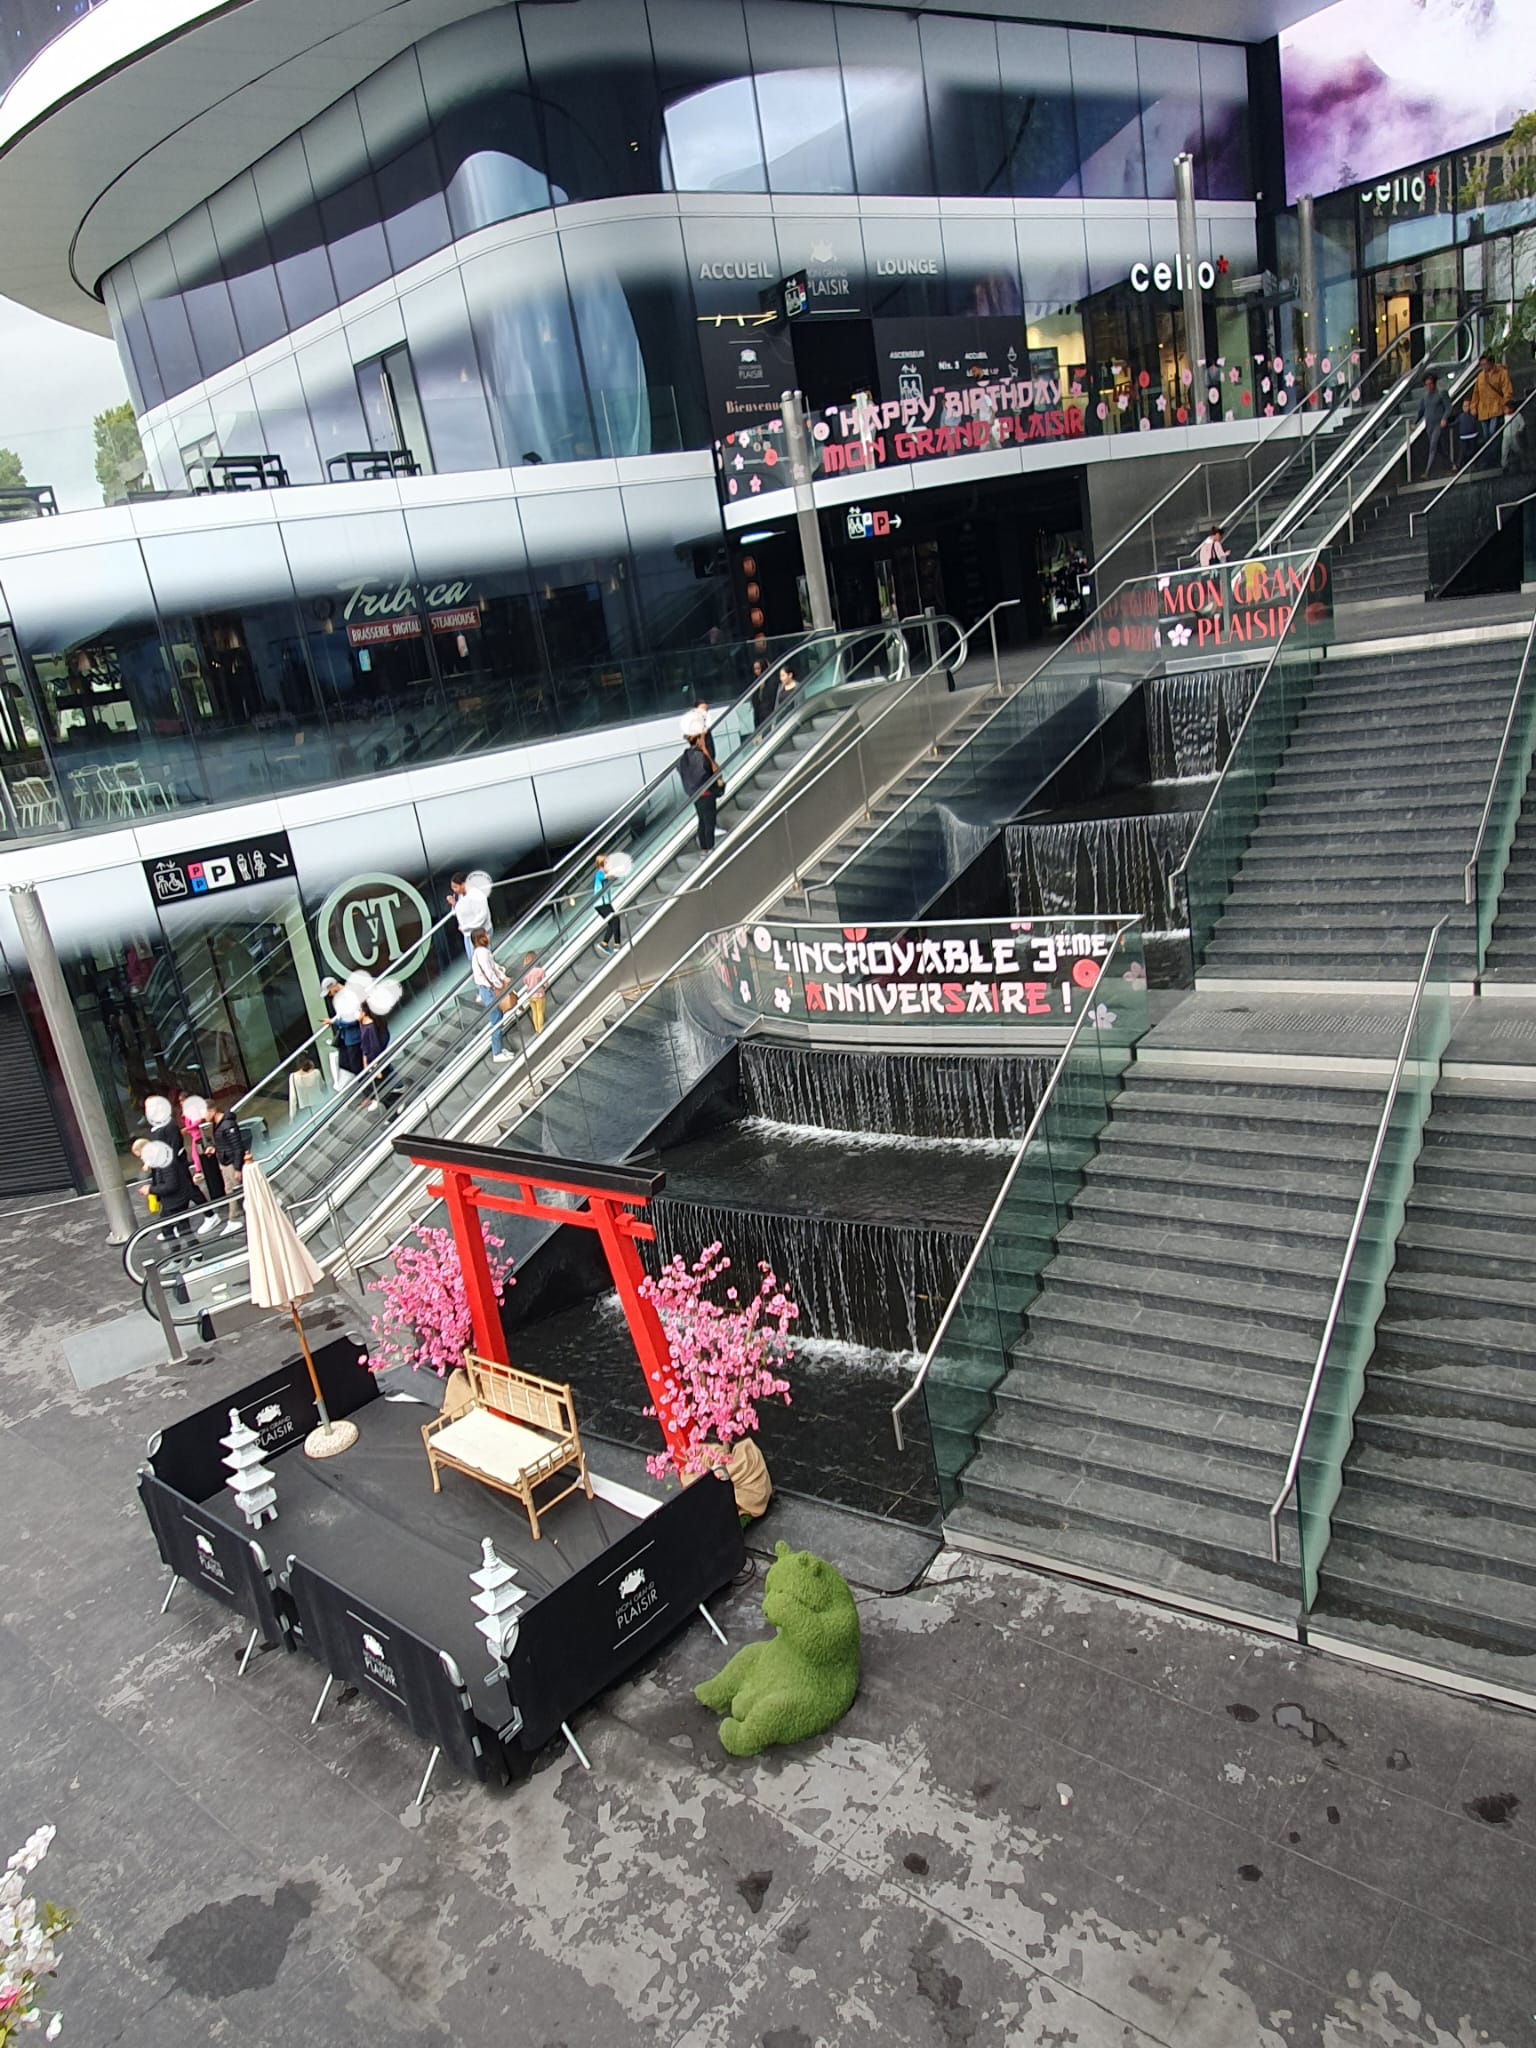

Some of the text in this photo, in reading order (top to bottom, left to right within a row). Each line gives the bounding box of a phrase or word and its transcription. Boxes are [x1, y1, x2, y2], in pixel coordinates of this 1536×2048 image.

[700, 262, 774, 280] ACCUEIL
[876, 258, 938, 276] LOUNGE
[1130, 253, 1215, 292] celio
[840, 379, 1061, 438] HAPPY BIRTHDAY
[823, 405, 1085, 474] MON GRAND PLAISIR
[338, 573, 472, 620] Tribca
[1162, 578, 1224, 616] MON
[1233, 561, 1328, 605] GRAND
[351, 611, 477, 643] BRASSERIE DIGITAL STEAKHOUSE
[1196, 605, 1296, 648] PLAISIR
[211, 865, 226, 882] P
[773, 938, 1020, 976] L'INCROYABLE
[805, 981, 1074, 1016] ANNIVERSAIRE !
[254, 1421, 294, 1447] PLAISIR
[617, 1589, 659, 1629] PLAISIR
